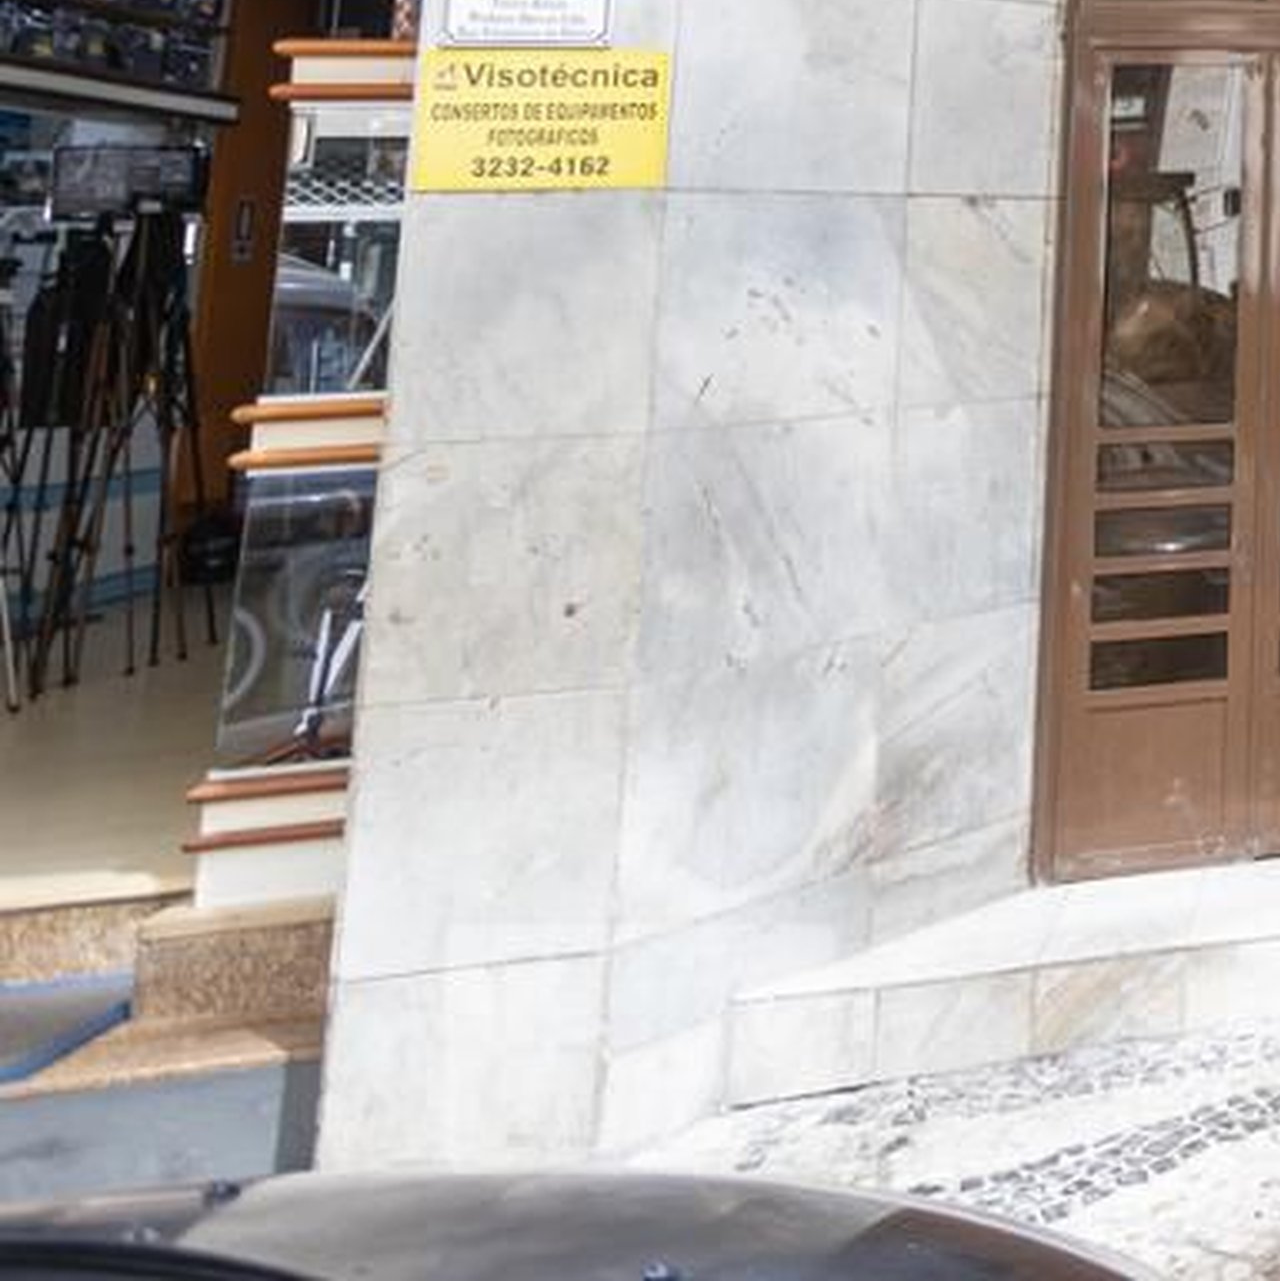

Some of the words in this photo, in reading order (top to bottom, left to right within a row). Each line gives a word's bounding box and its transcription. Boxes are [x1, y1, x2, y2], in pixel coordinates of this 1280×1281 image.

[463, 61, 660, 90] Visotécnica
[430, 101, 519, 122] CONSERTOS
[523, 102, 544, 121] DE
[546, 101, 659, 122] EQUIPAMENTOS
[471, 156, 610, 178] 3232-4162
